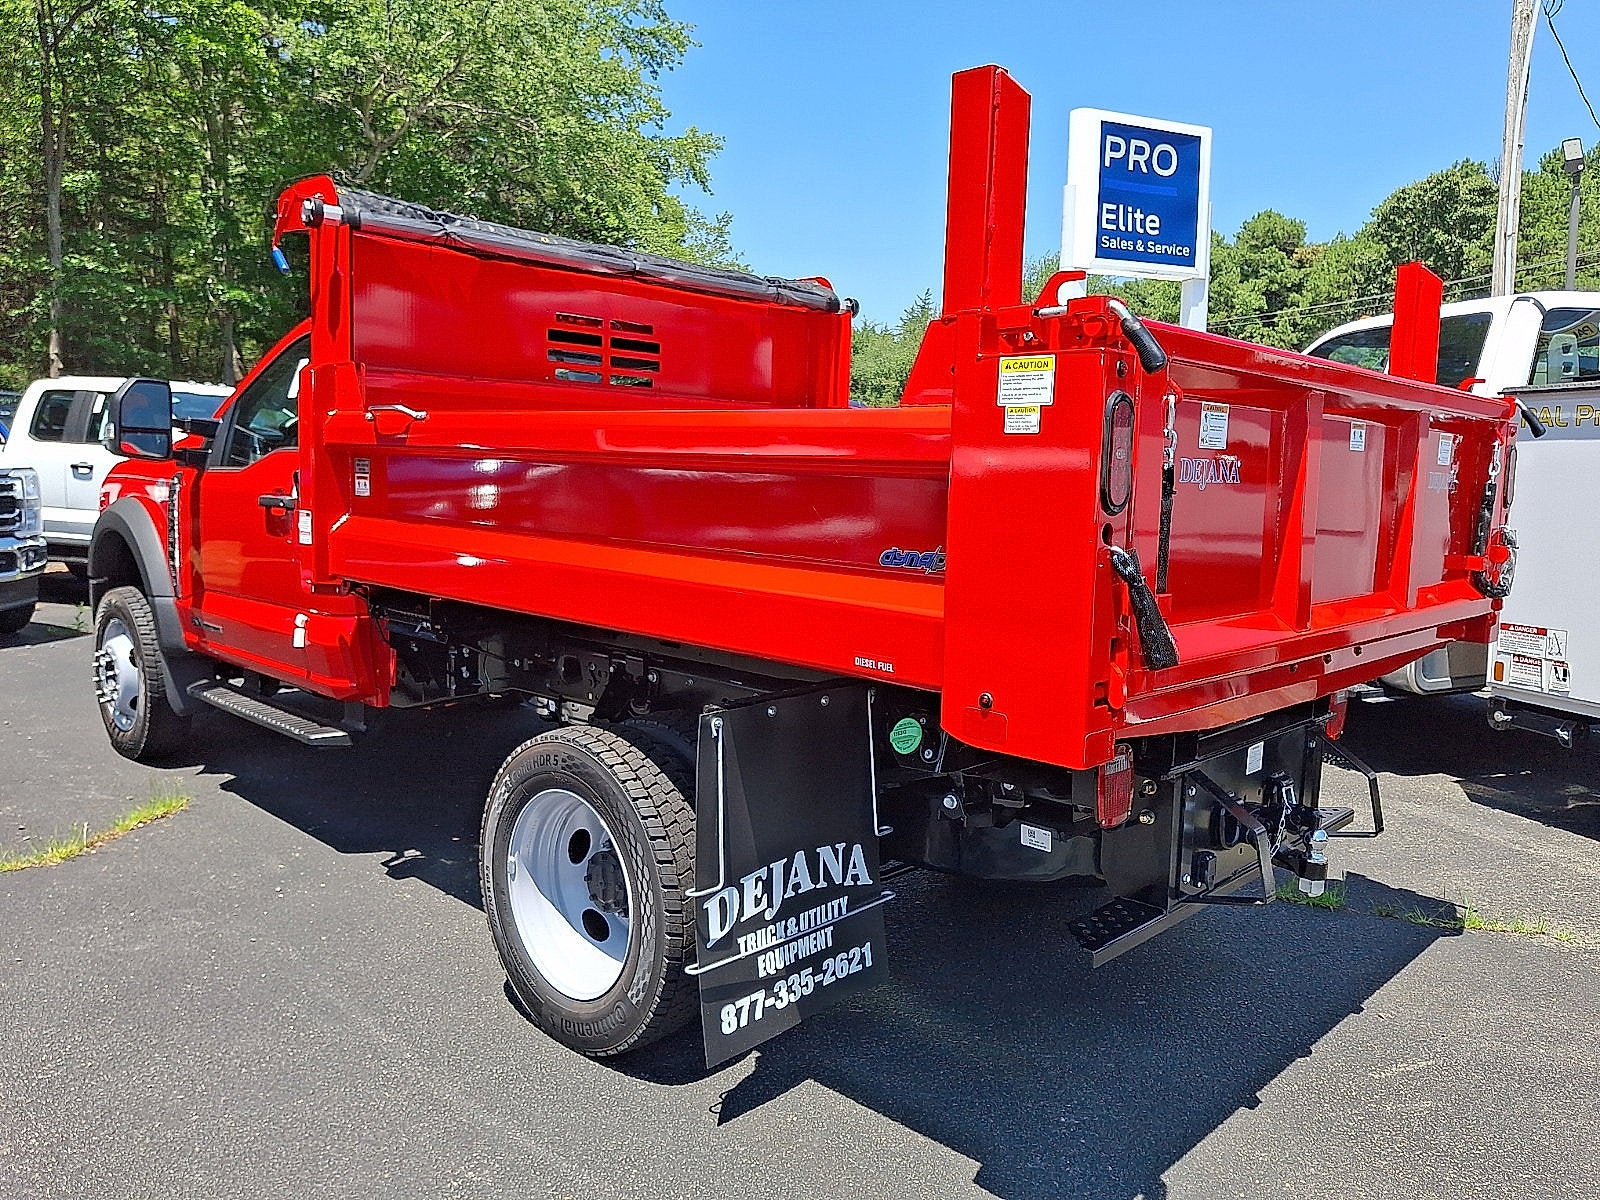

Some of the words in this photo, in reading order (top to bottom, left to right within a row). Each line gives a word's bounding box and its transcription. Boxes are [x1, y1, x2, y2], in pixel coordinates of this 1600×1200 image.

[1104, 134, 1178, 177] PRO
[1101, 202, 1160, 235] Elite
[1101, 235, 1134, 251] Sales
[1136, 240, 1145, 252] &
[1147, 242, 1190, 256] Service
[1012, 360, 1049, 370] CAUTION
[1179, 457, 1241, 491] DEJANA
[855, 657, 876, 670] DIESEL
[878, 661, 894, 673] FUEL
[552, 754, 559, 767] 5
[702, 842, 873, 949] DEJANA
[736, 920, 787, 954] TRUCK
[786, 916, 799, 937] &
[799, 895, 849, 932] UTILITY
[757, 926, 834, 978] EQUIPMENT
[720, 941, 874, 1036] 877-335-2621
